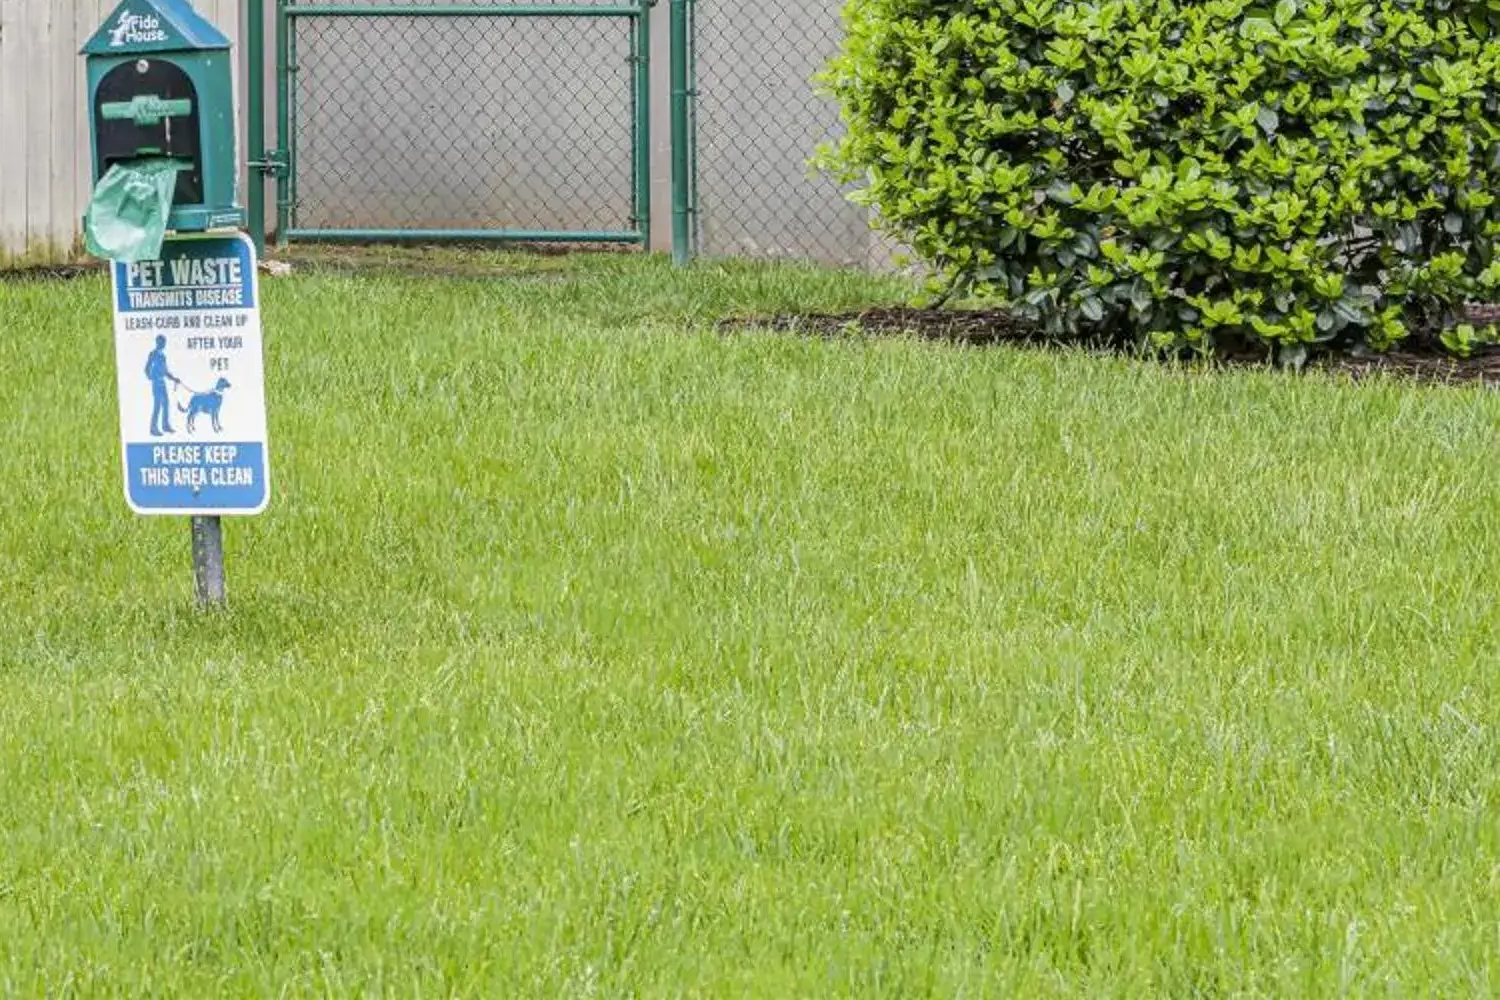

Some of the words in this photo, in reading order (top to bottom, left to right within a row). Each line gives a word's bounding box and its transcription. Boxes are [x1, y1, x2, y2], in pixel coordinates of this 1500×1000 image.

[129, 14, 158, 28] Fido
[126, 259, 164, 287] PET
[170, 257, 242, 286] WASTE
[129, 290, 193, 308] TRANSMITS
[196, 289, 243, 306] DISEASE
[183, 315, 201, 329] AND
[203, 315, 233, 328] CLEAN
[235, 314, 248, 327] UP
[187, 336, 215, 349] AFTER
[218, 335, 243, 349] YOUR
[210, 357, 229, 371] PET
[153, 445, 201, 465] PLEASE
[205, 445, 237, 465] KEEP
[140, 467, 170, 486] THIS
[173, 467, 208, 486] AREA
[211, 466, 253, 486] CLEAN
